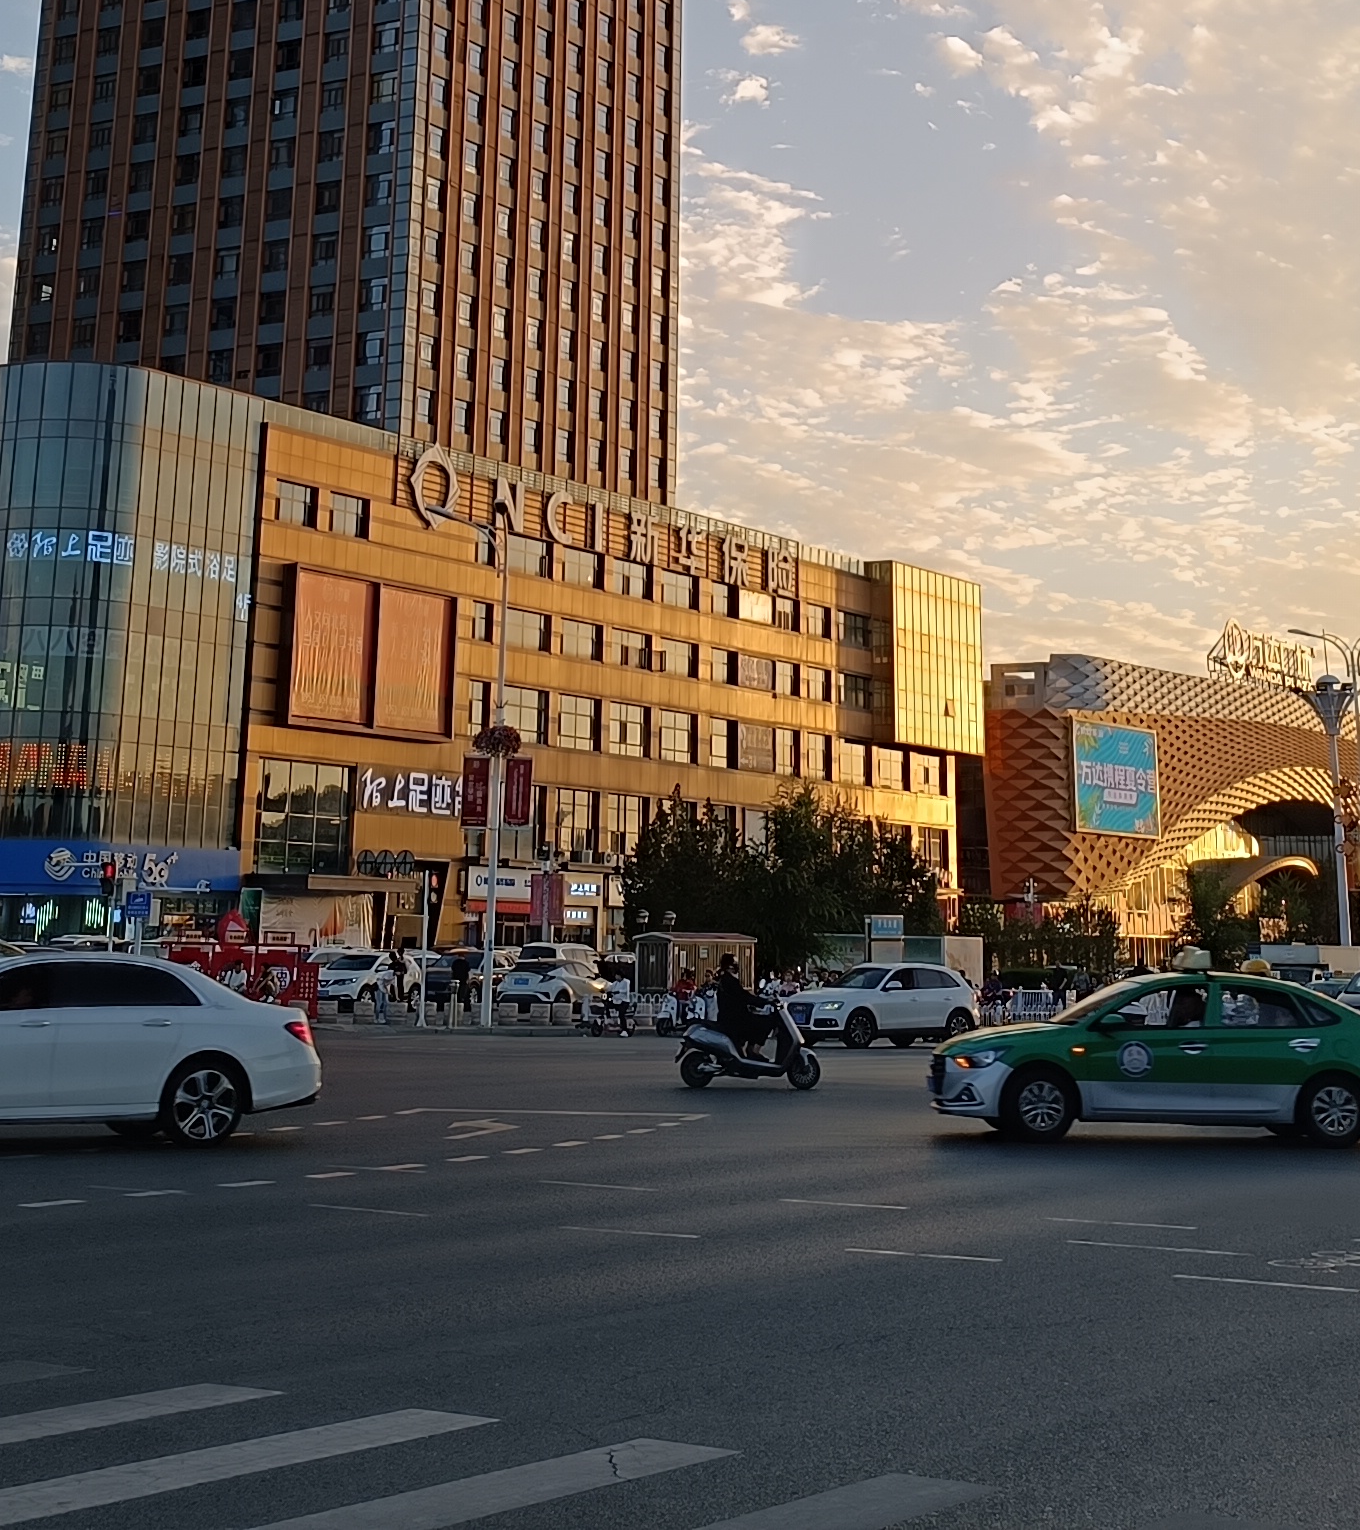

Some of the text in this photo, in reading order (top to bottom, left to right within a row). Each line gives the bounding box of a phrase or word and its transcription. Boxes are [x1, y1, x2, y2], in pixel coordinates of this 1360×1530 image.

[496, 476, 798, 598] NCI 新华保险
[153, 541, 237, 583] 影院式浴足
[83, 850, 138, 868] 中国移动
